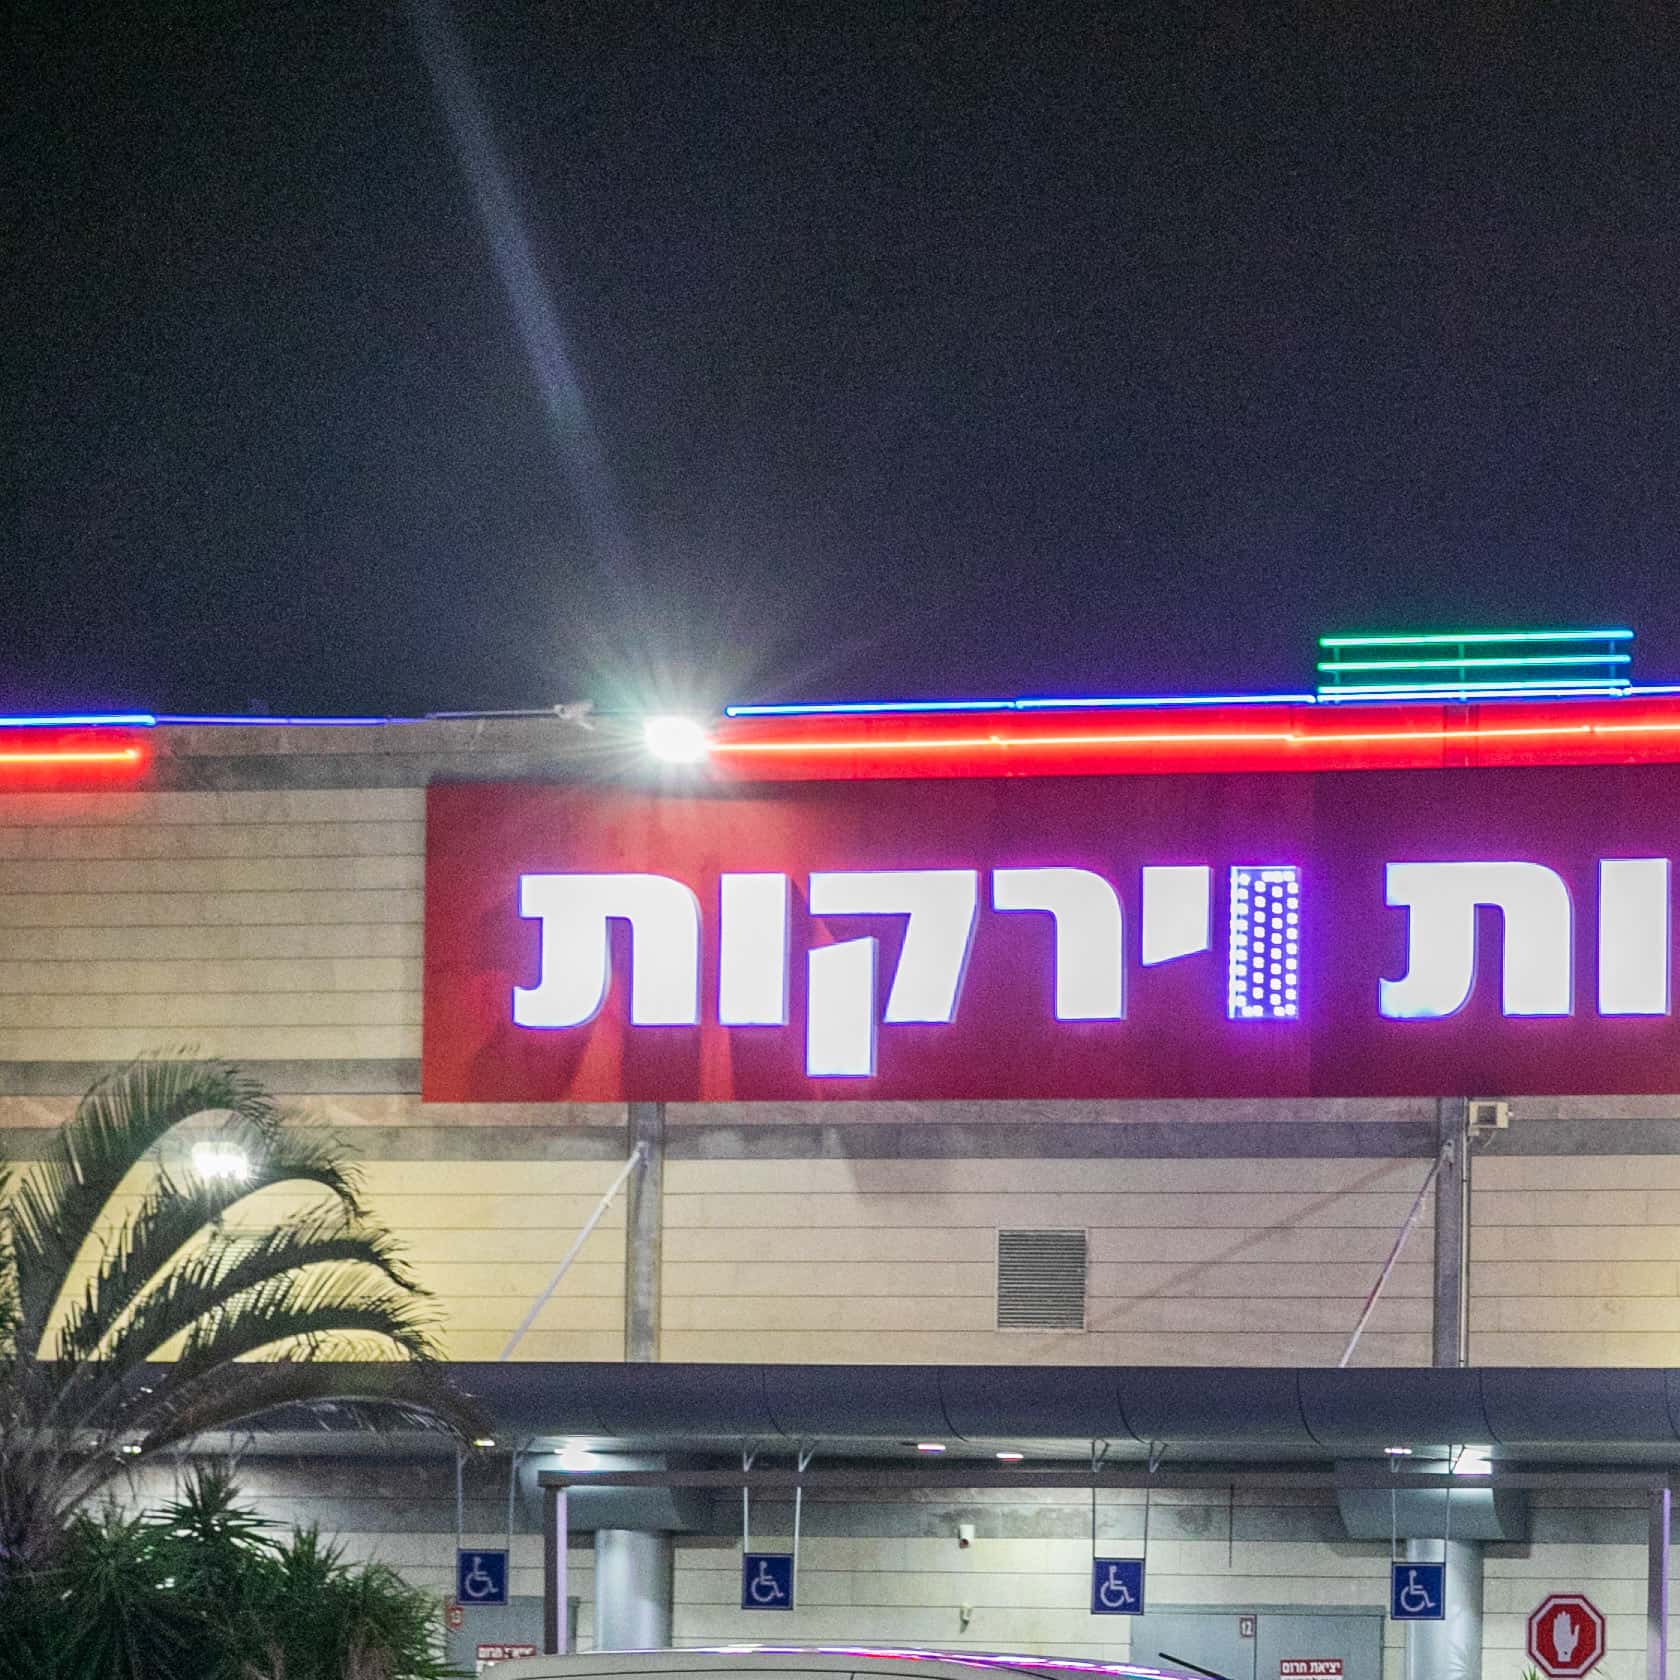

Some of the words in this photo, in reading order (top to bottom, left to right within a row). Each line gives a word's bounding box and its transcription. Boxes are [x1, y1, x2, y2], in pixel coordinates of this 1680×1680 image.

[511, 863, 1300, 1078] וירקות
[1282, 1661, 1307, 1673] חרום
[1310, 1661, 1341, 1673] יציאת
